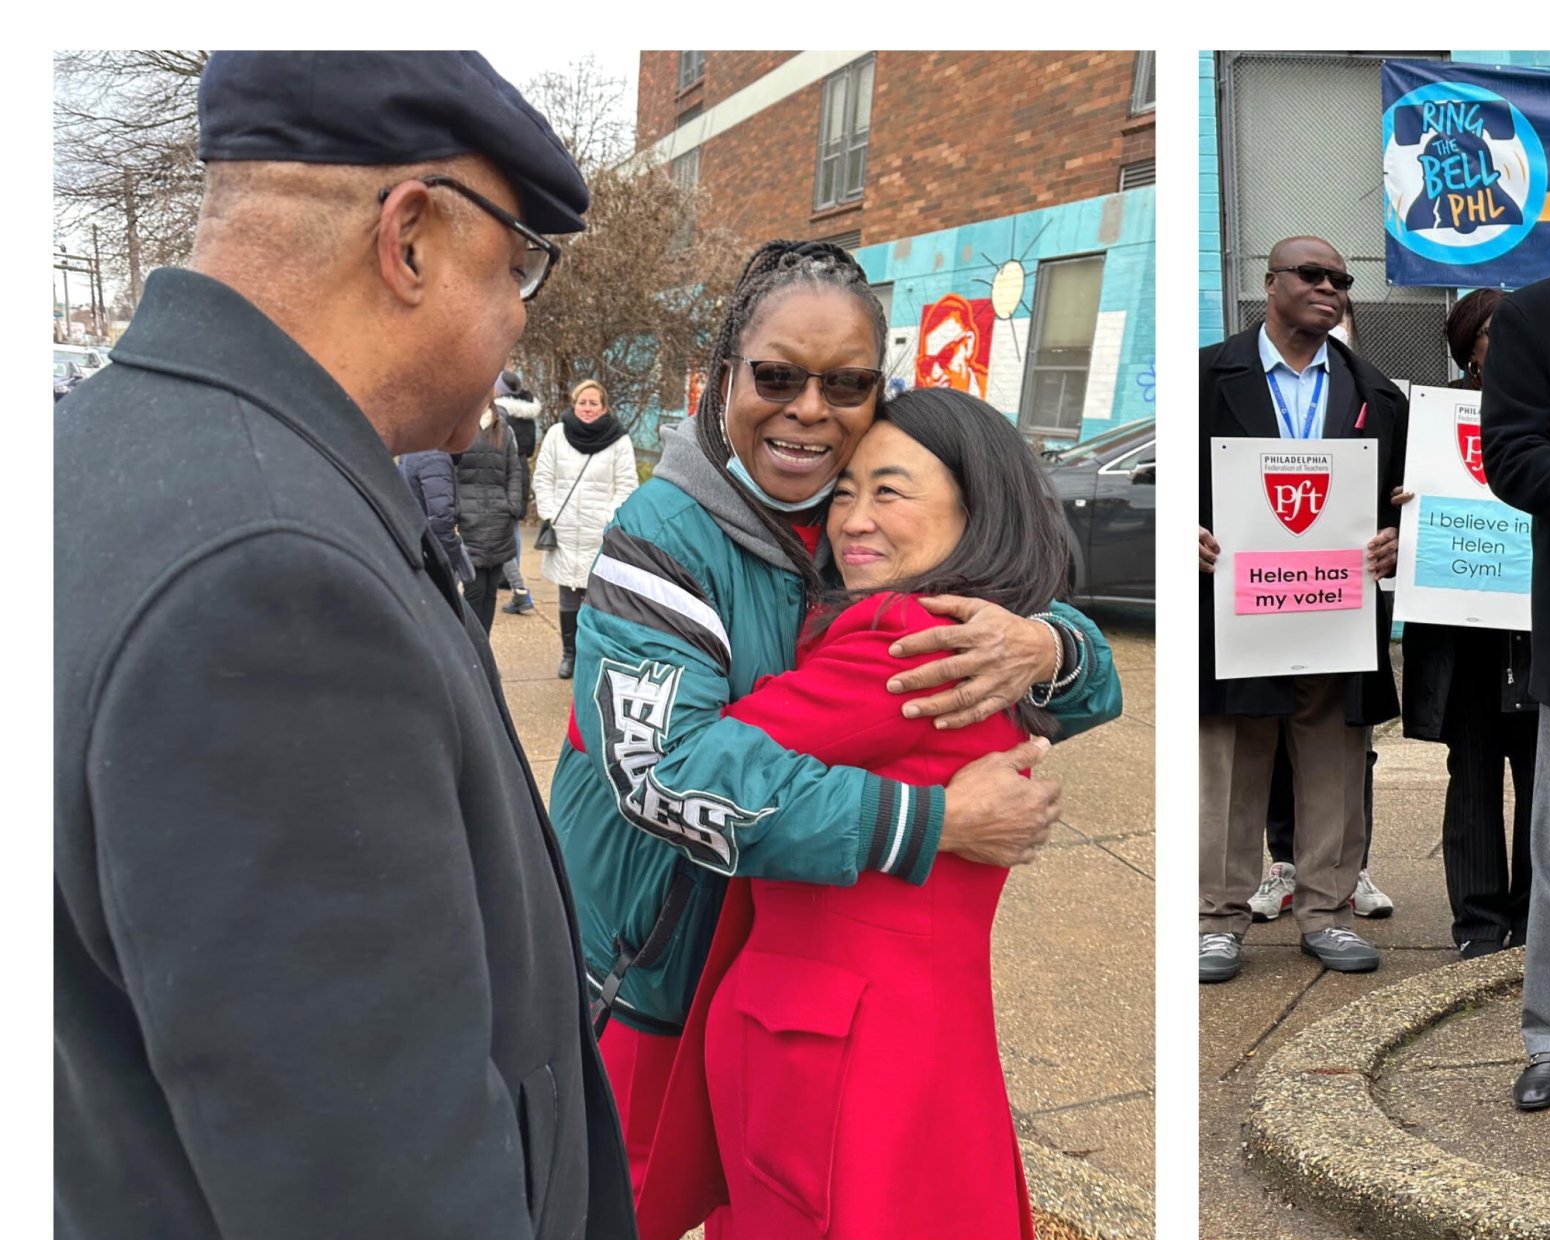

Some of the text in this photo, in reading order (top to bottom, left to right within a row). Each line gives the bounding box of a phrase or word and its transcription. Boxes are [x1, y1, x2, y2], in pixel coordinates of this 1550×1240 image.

[1422, 102, 1485, 137] RING
[1432, 138, 1459, 155] THE
[1419, 150, 1500, 199] BELL
[1447, 188, 1505, 227] PHL
[1264, 456, 1328, 464] PHILADELPHIA
[1273, 480, 1323, 521] pft
[1429, 512, 1530, 534] I believe in
[1451, 536, 1506, 555] Helen
[1249, 565, 1349, 584] Helen has
[1451, 558, 1503, 581] Gym!
[1255, 588, 1343, 609] my vote!
